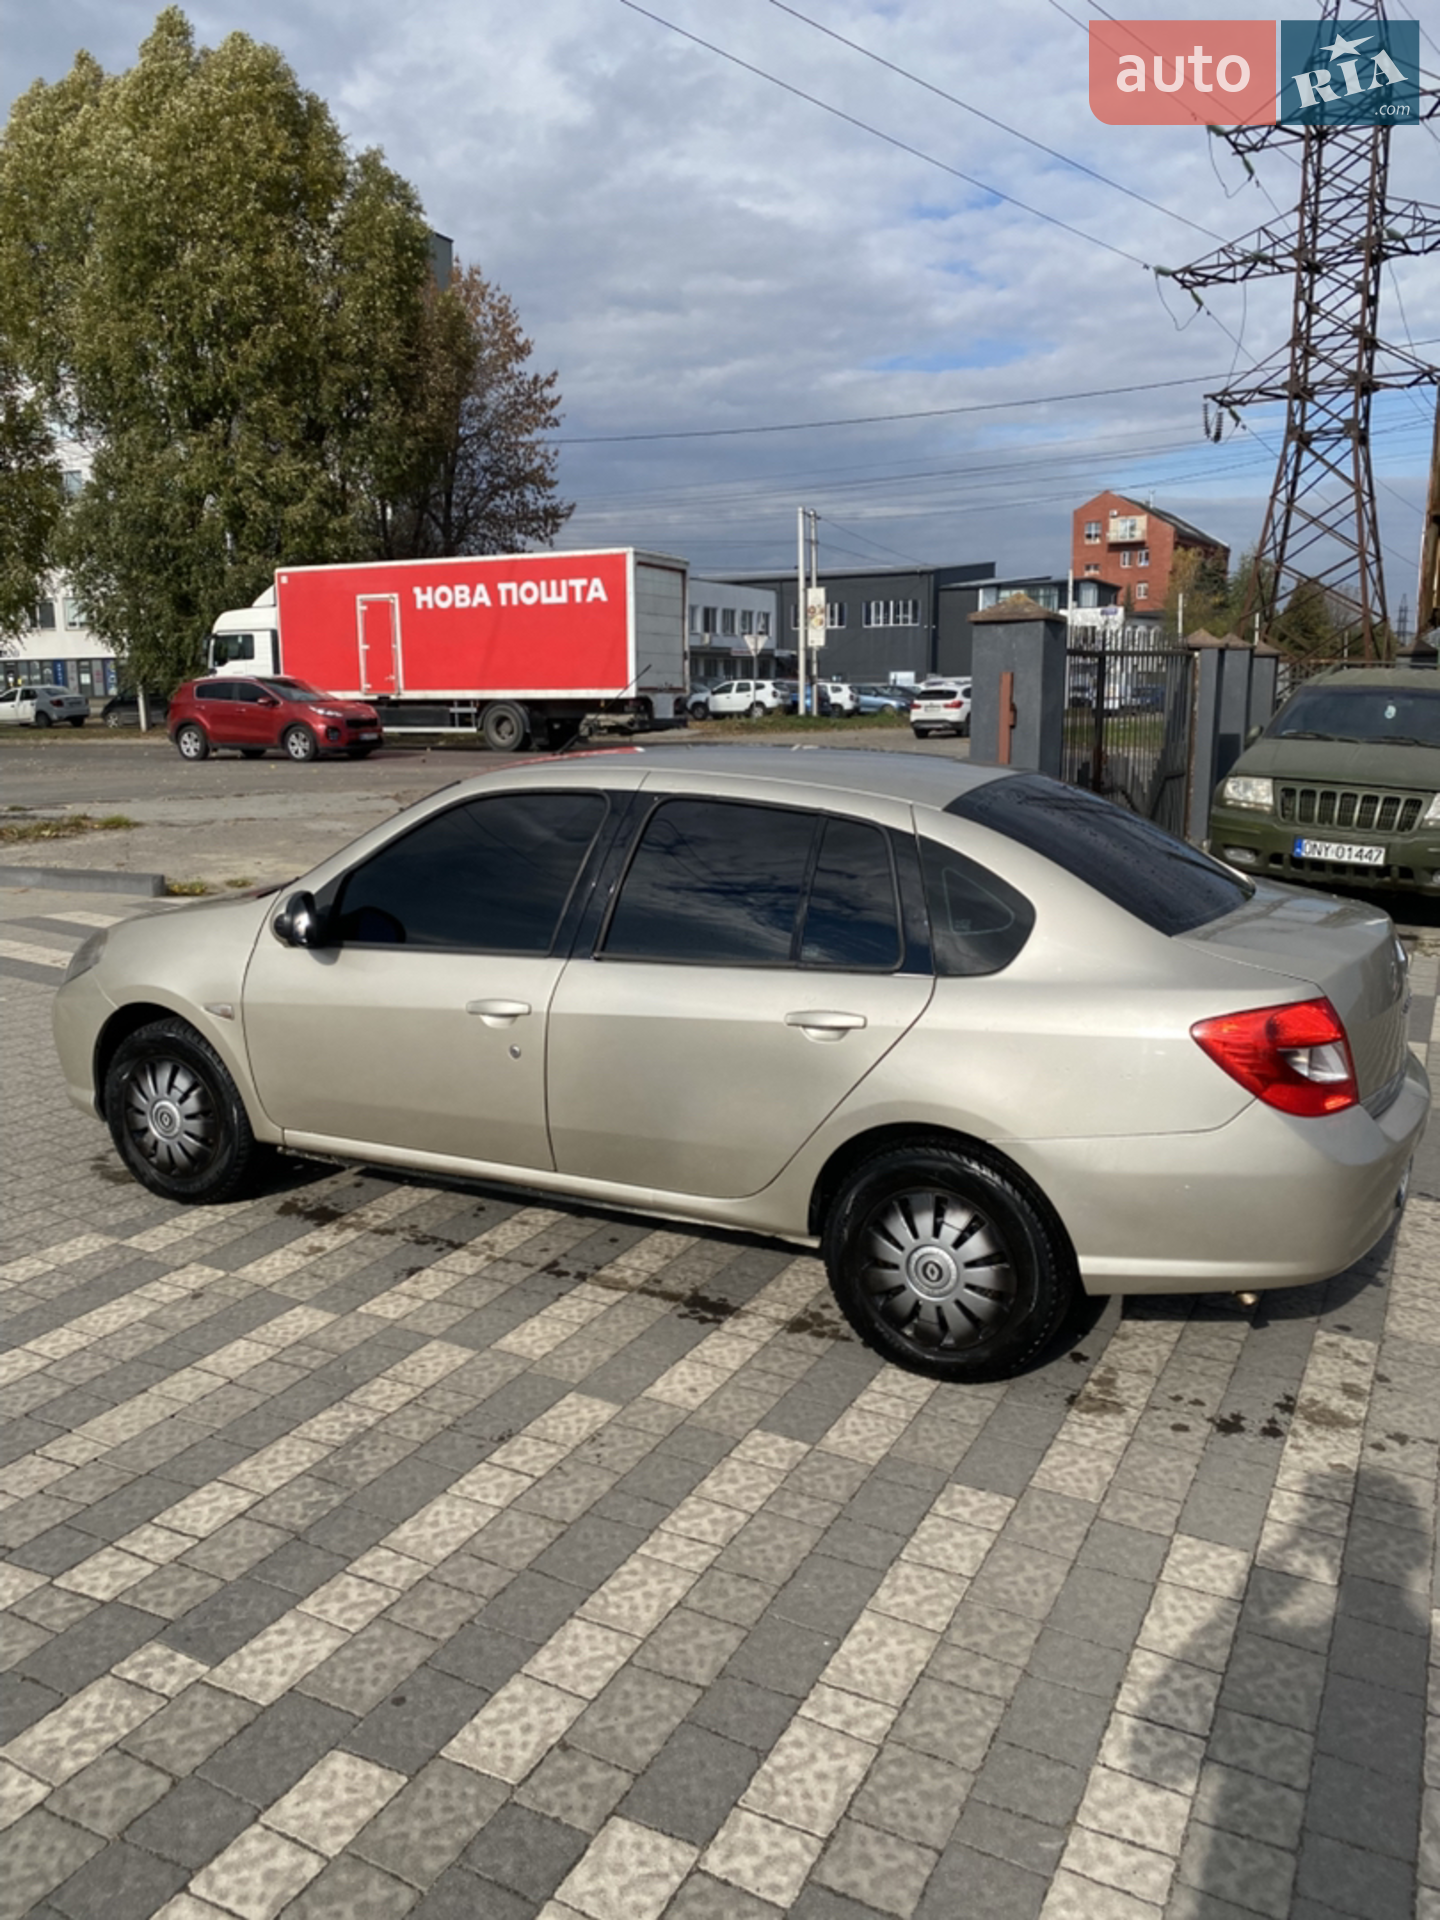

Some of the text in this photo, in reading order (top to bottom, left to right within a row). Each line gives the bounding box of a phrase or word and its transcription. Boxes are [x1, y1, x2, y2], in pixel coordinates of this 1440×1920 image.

[413, 577, 608, 610] НОВА ПОШТА
[1335, 845, 1383, 862] 01447
